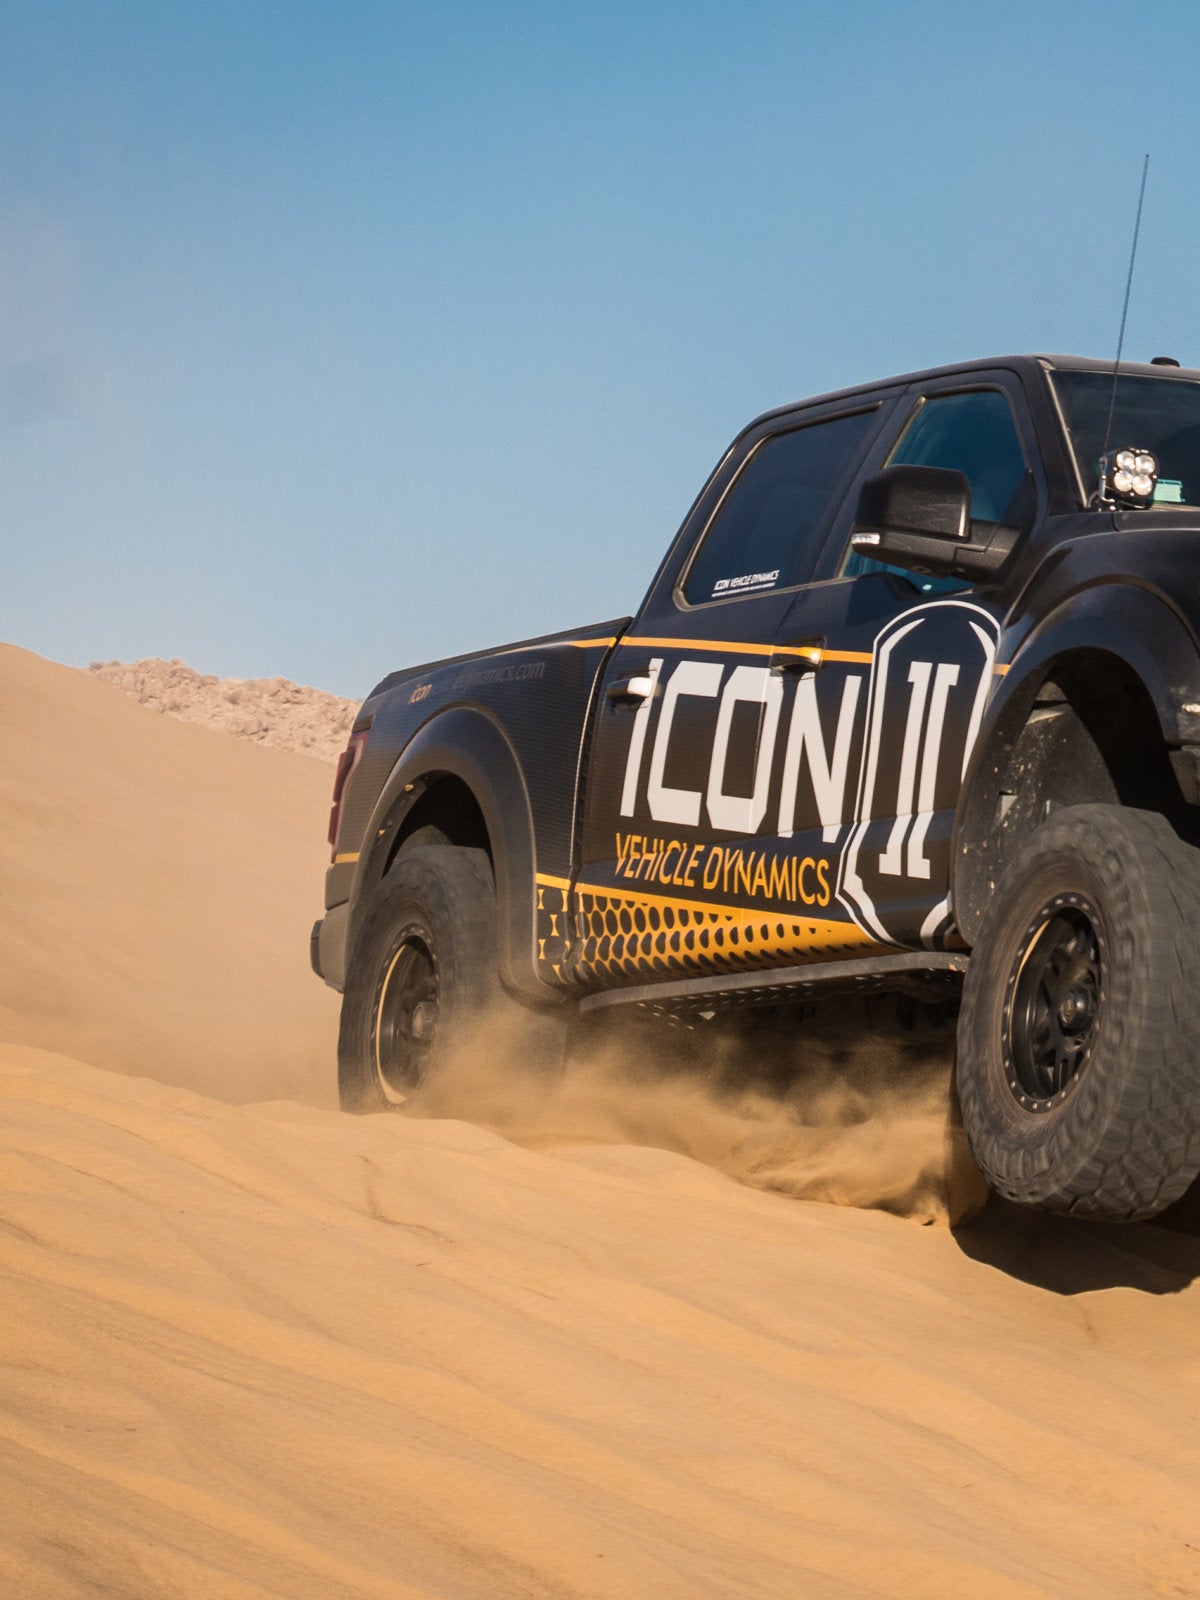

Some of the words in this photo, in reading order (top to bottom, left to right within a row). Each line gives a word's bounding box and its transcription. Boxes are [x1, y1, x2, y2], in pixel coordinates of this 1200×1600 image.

[619, 657, 862, 844] ICON
[614, 832, 706, 888] VEHICLE
[702, 846, 831, 908] DYNAMICS
